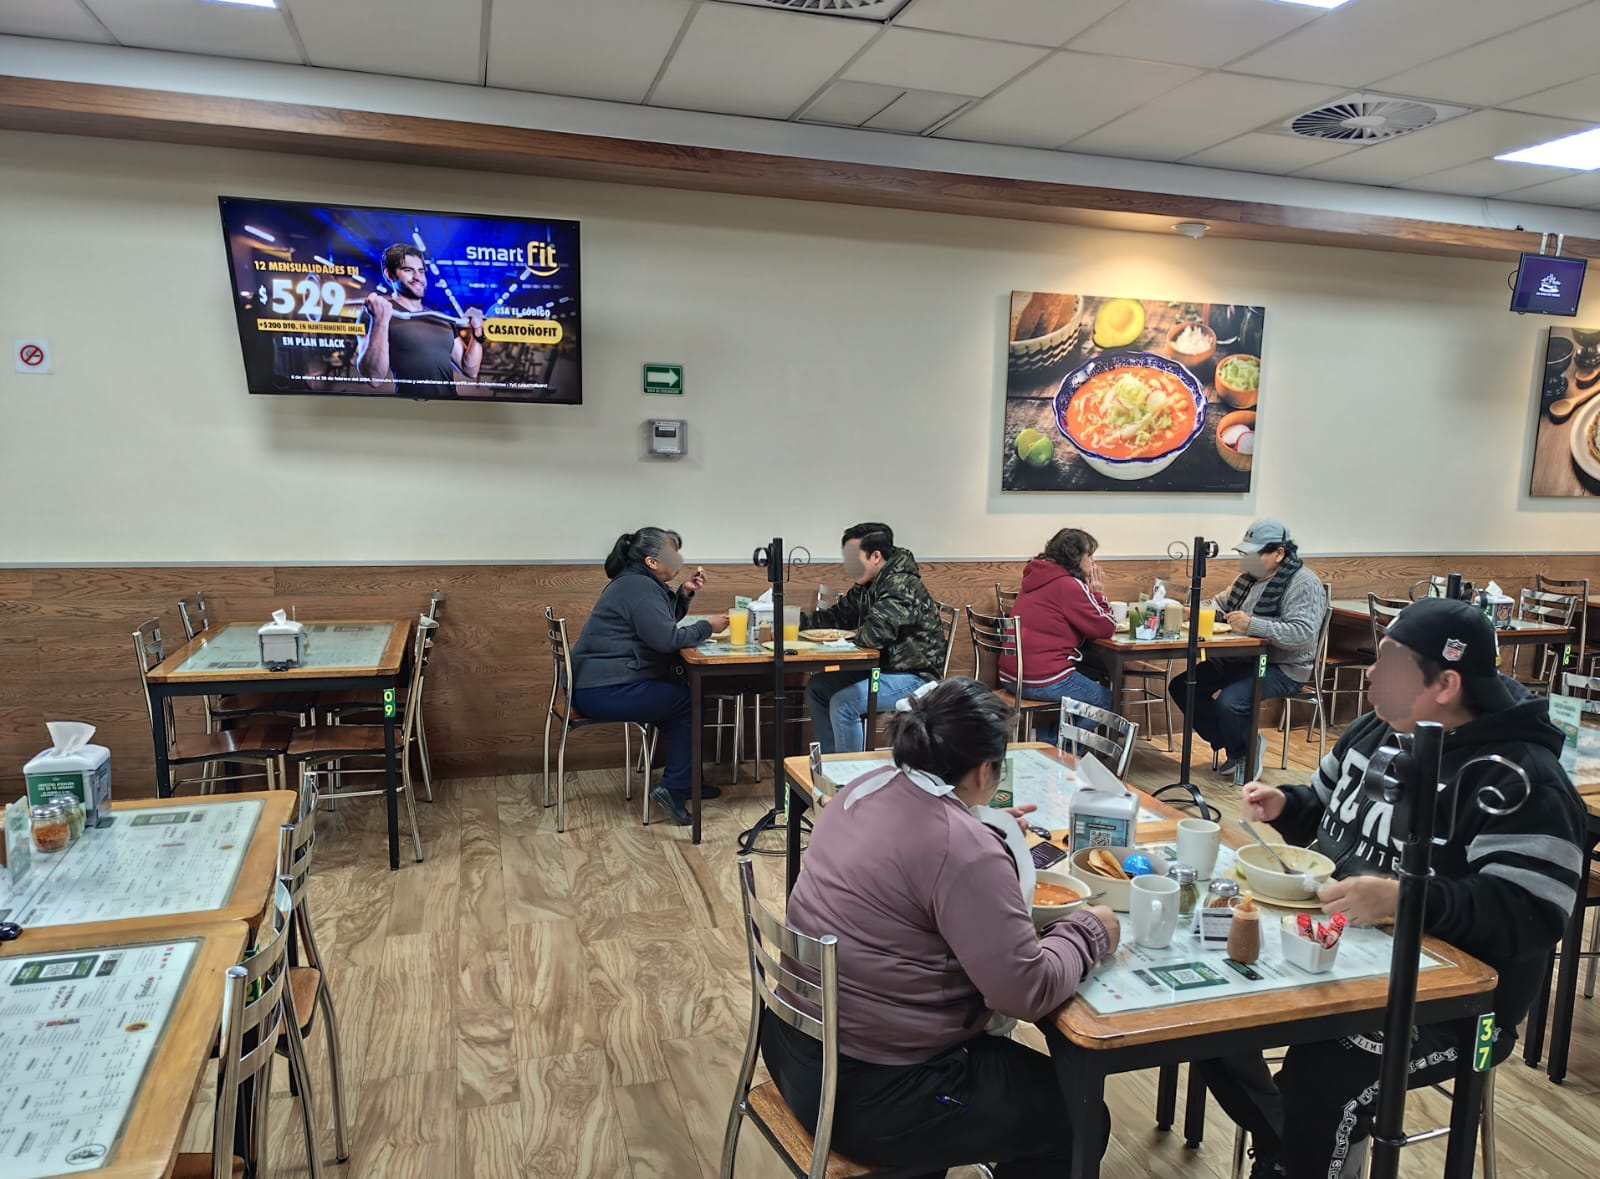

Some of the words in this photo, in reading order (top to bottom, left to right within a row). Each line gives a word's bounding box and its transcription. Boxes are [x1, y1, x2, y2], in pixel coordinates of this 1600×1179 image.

[466, 246, 524, 262] smart
[527, 241, 558, 267] fit
[254, 260, 266, 271] 12
[269, 261, 344, 275] MENSUALIDADES
[347, 265, 359, 275] EN
[495, 307, 510, 315] USA
[512, 307, 520, 315] EL
[487, 324, 558, 337] CASATOÑOFIT
[282, 336, 295, 346] EN
[295, 337, 317, 347] PLAN
[318, 338, 345, 348] BLACK
[1259, 657, 1267, 677] 07
[871, 670, 880, 692] 08
[383, 691, 394, 716] 09
[1478, 1018, 1493, 1069] 37
